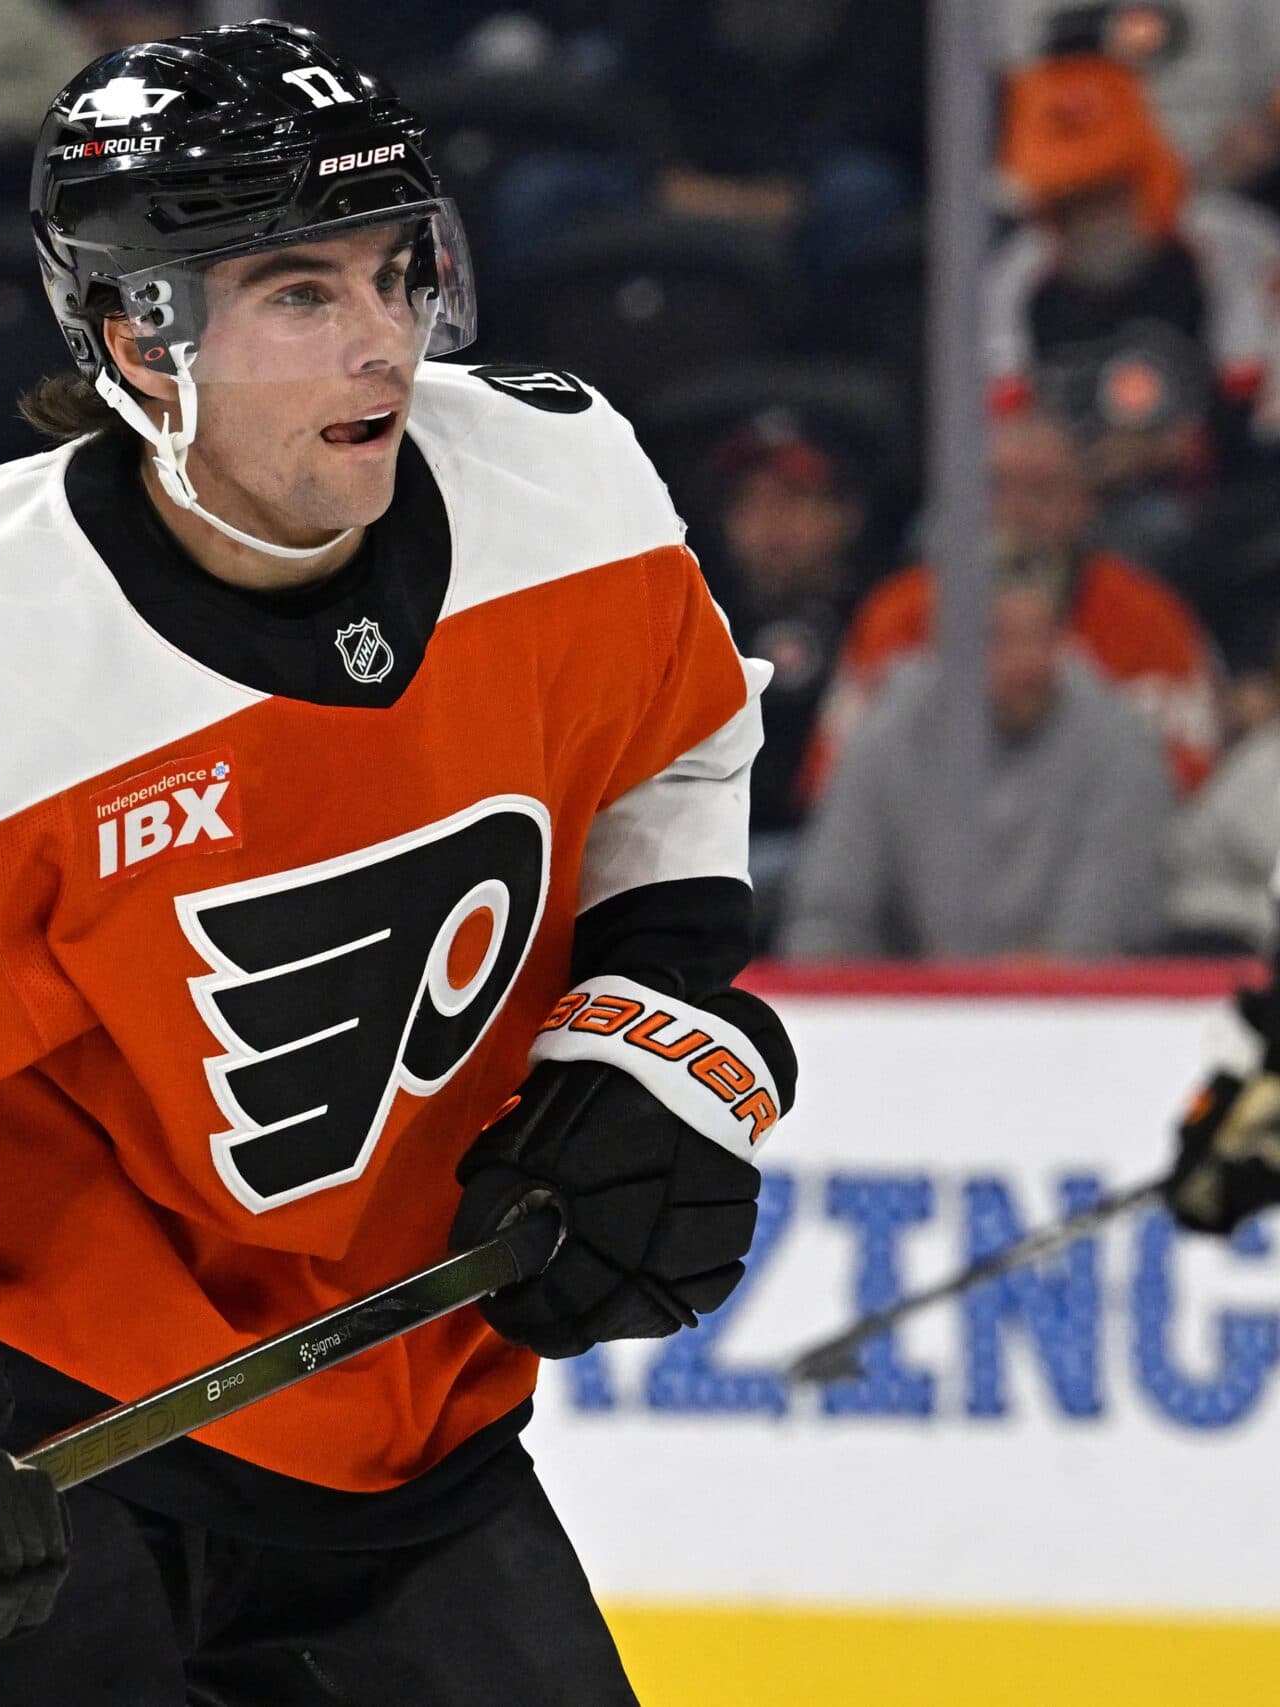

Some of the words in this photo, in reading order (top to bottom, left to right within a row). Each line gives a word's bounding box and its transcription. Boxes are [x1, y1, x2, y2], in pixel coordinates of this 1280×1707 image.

[282, 66, 355, 109] 17
[63, 136, 164, 161] CHEVROLET
[355, 635, 376, 673] NHL
[96, 769, 208, 819] Independence
[98, 780, 235, 880] IBX
[565, 1172, 1280, 1430] ZING
[221, 1372, 245, 1393] PRO
